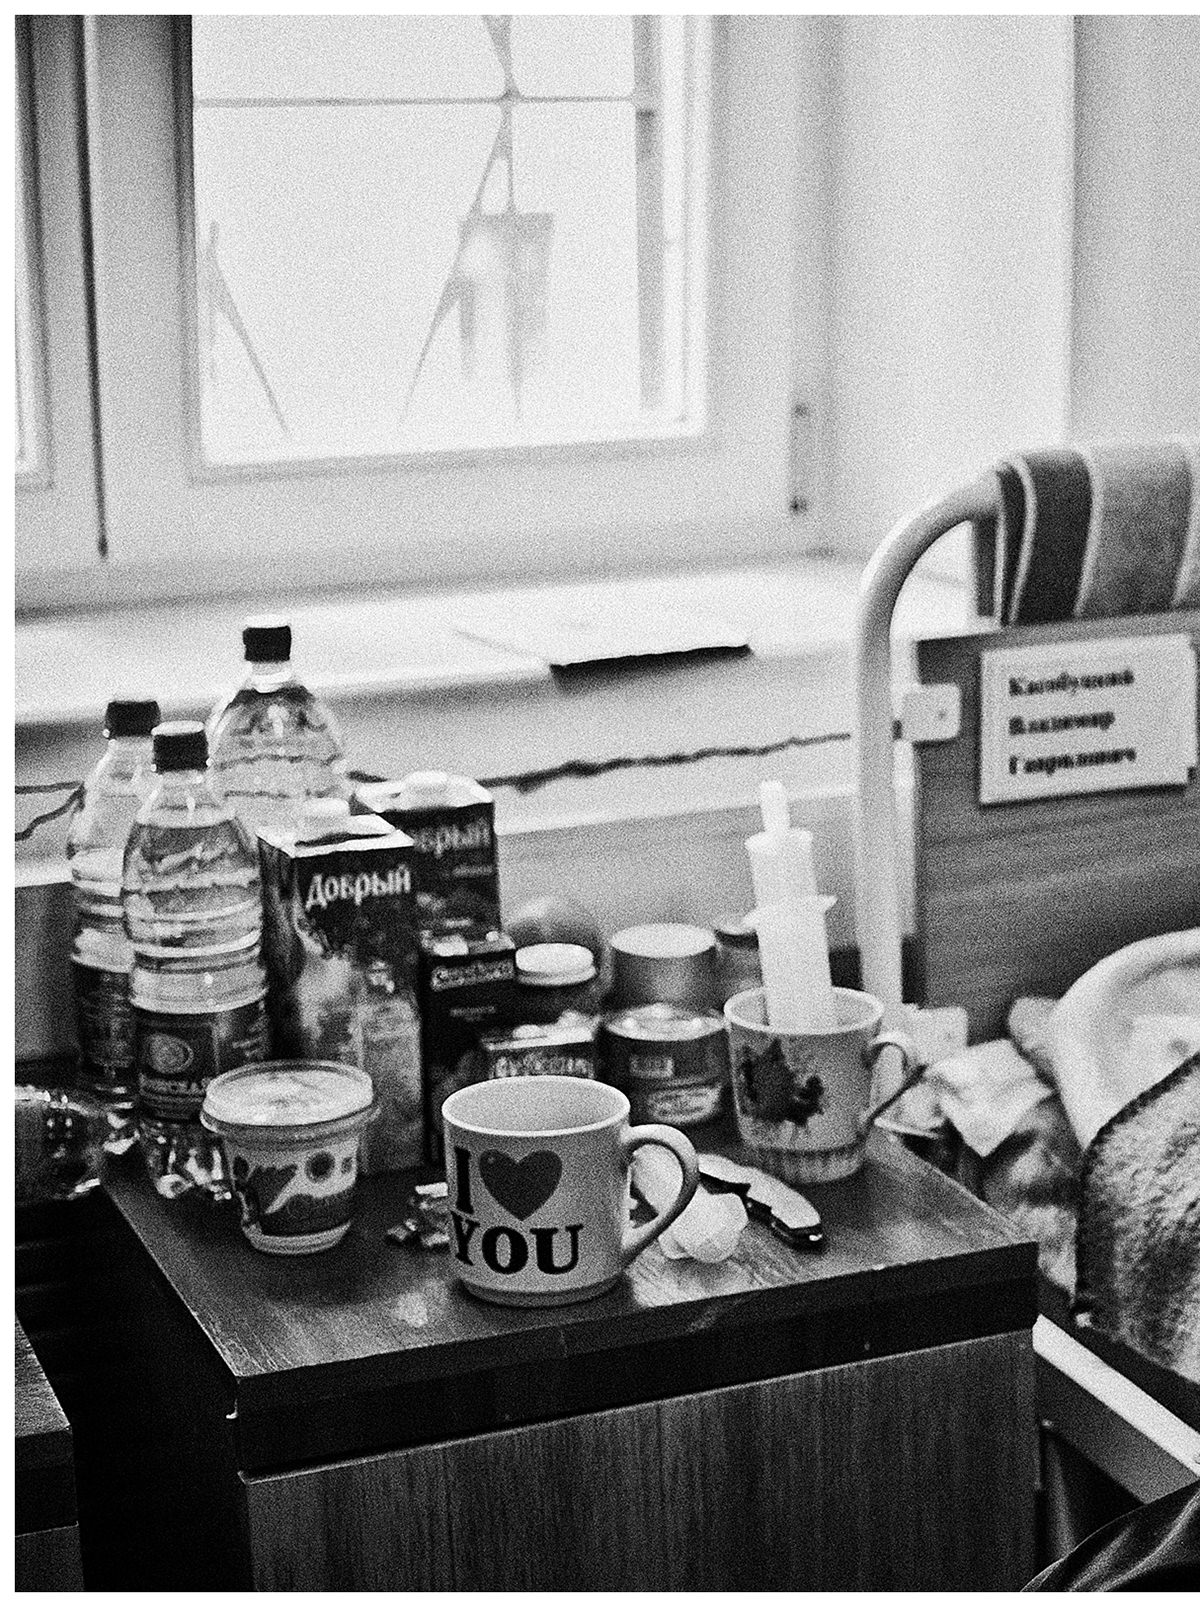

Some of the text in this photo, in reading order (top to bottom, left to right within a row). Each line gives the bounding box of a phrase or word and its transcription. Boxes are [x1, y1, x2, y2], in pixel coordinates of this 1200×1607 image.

[1008, 710, 1116, 736] Владимир
[304, 863, 412, 912] Добрый
[454, 1146, 475, 1215] I
[450, 1210, 584, 1276] YOU
